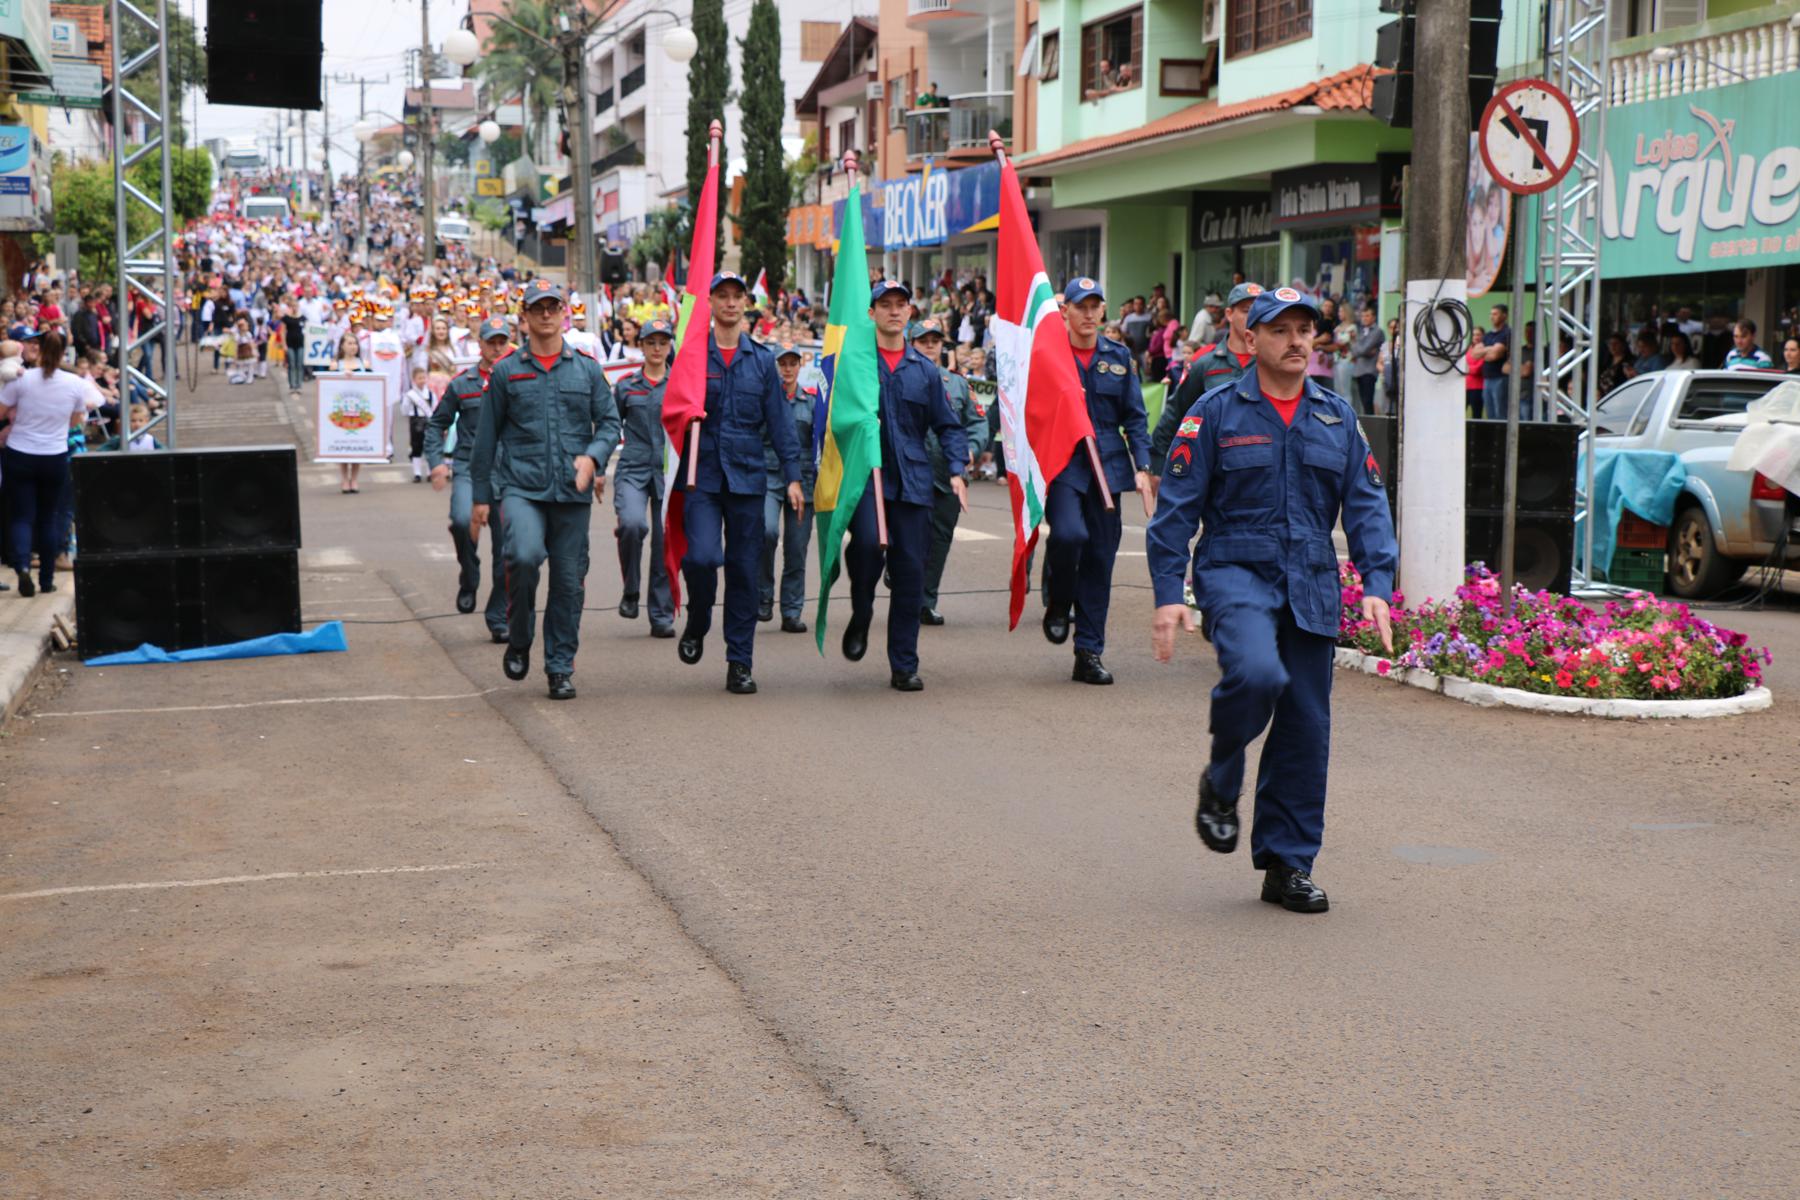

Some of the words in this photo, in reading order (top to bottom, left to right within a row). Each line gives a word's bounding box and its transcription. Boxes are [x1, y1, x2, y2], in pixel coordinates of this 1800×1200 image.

[1635, 129, 1699, 171] Lojas
[883, 173, 947, 246] BECKER
[1299, 182, 1326, 214] Studio
[1328, 176, 1361, 210] Marino
[1709, 239, 1757, 258] acerte
[1761, 236, 1783, 253] no
